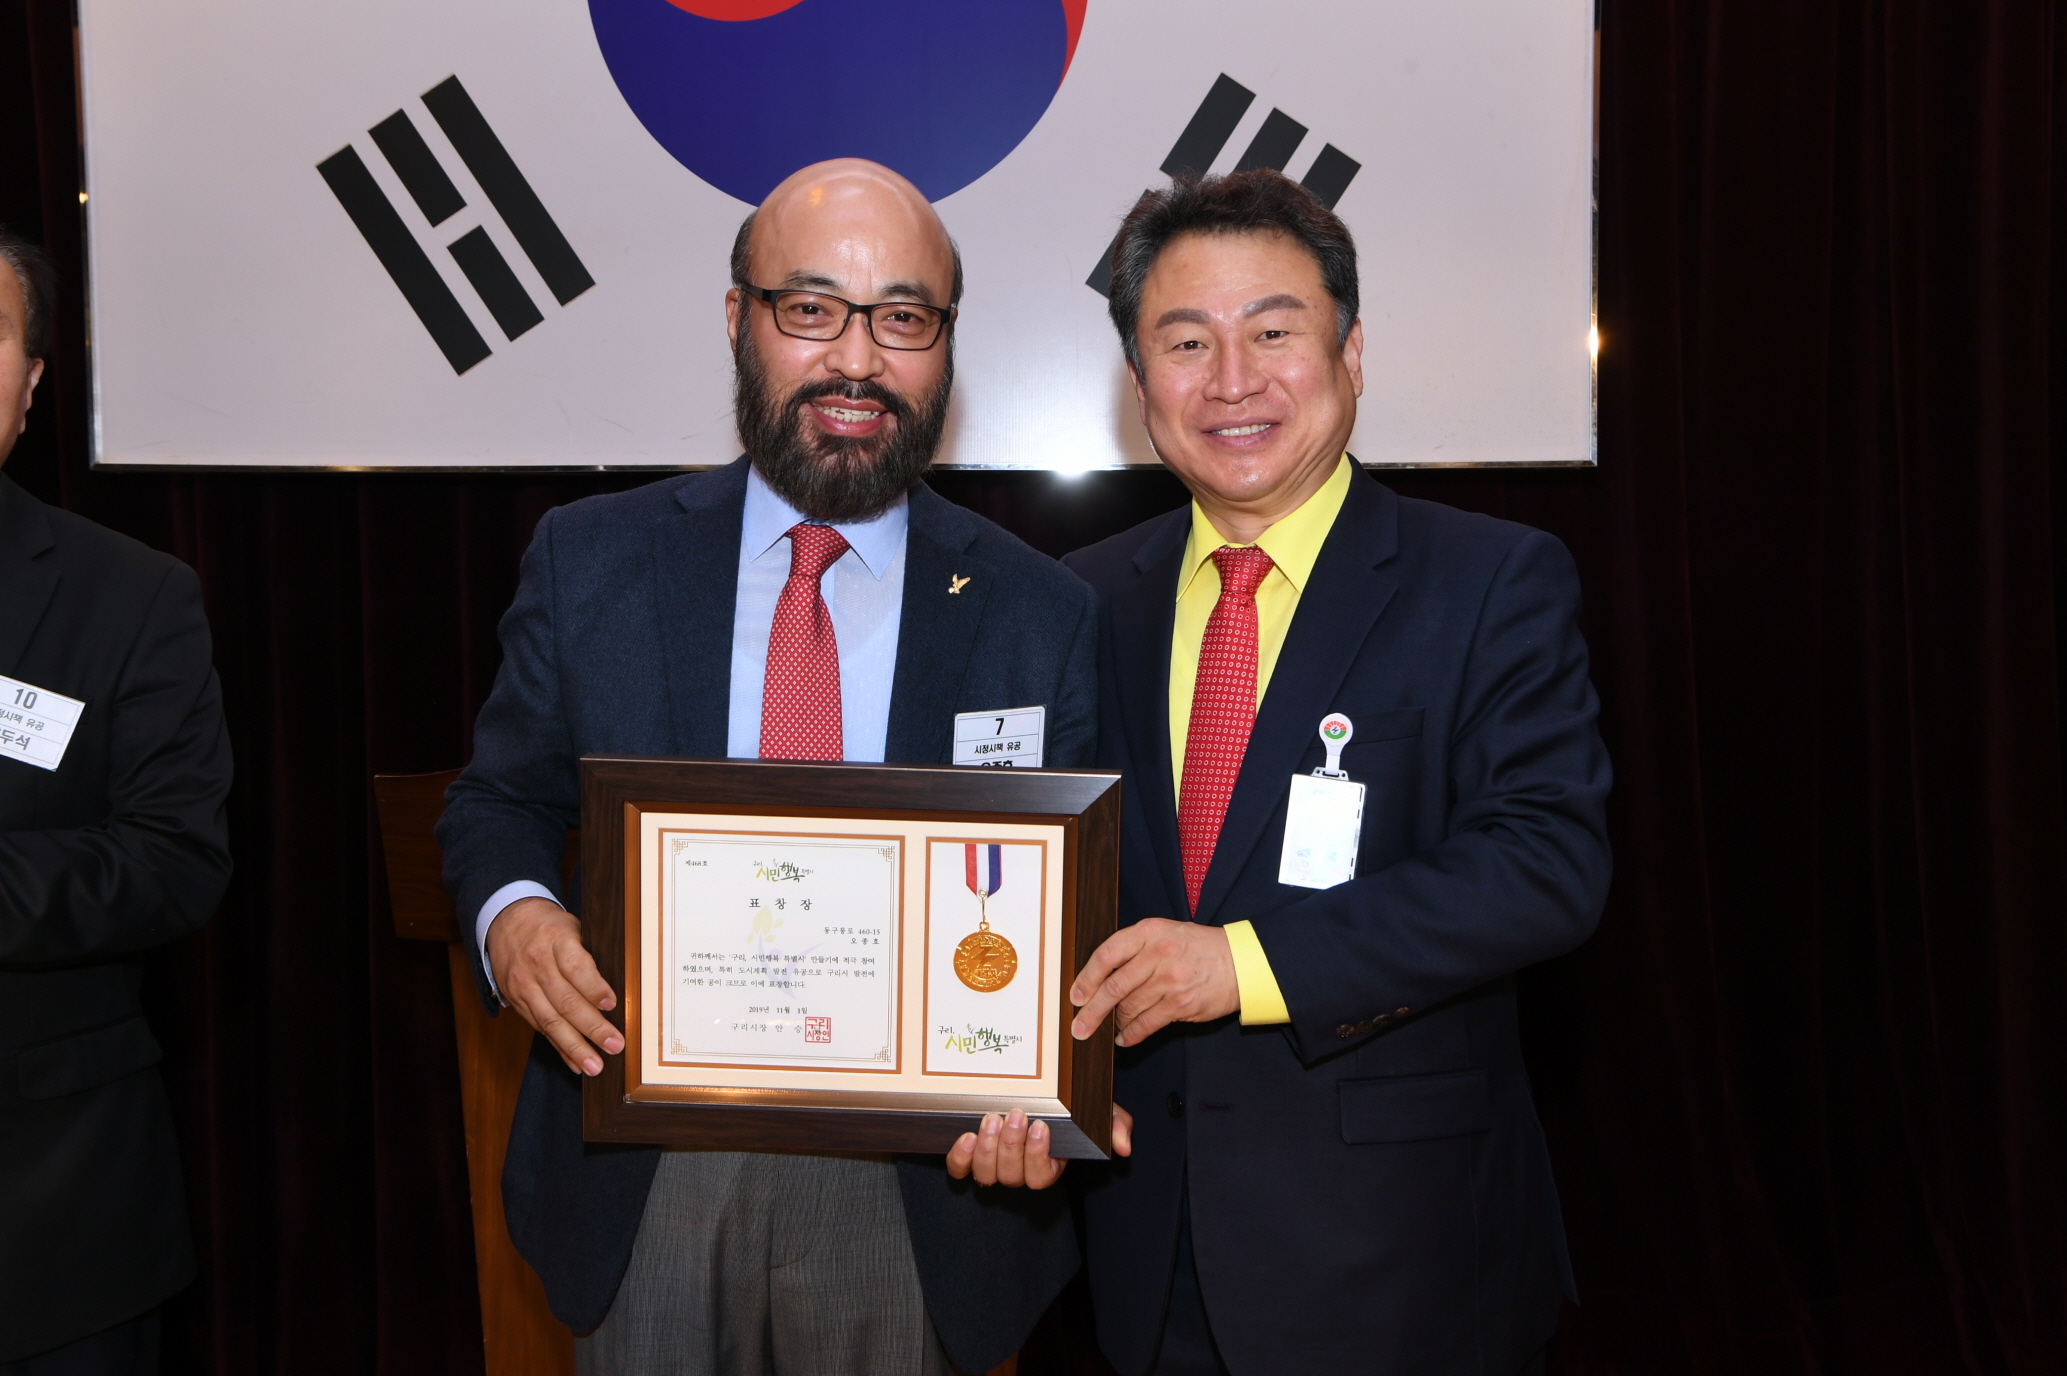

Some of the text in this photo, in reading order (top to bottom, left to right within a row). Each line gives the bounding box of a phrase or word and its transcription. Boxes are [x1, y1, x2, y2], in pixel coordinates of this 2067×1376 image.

[14, 688, 38, 709] 10
[26, 718, 45, 731] 유공
[995, 717, 1005, 736] 7
[0, 728, 31, 750] 두석
[974, 740, 1021, 755] 시정시책 유공
[756, 861, 806, 883] 시민행복
[857, 928, 881, 936] 460-15
[690, 952, 726, 961] 귀하께서는
[750, 953, 780, 963] 시민행복
[810, 955, 839, 964] 만들기에
[718, 966, 733, 974] 특히
[738, 966, 768, 975] 도시계획
[792, 968, 823, 977] 유공으로
[826, 969, 849, 977] 구리시
[853, 970, 876, 978] 발전에
[682, 977, 807, 990] 기여한 공이 크므로 이에 표창합니다.
[748, 1006, 808, 1015] 2019년 11월 1일
[731, 1022, 767, 1033] 구리시장
[806, 1018, 829, 1030] 구리
[806, 1030, 830, 1041] 시장인
[944, 1027, 1010, 1055] 시민행복
